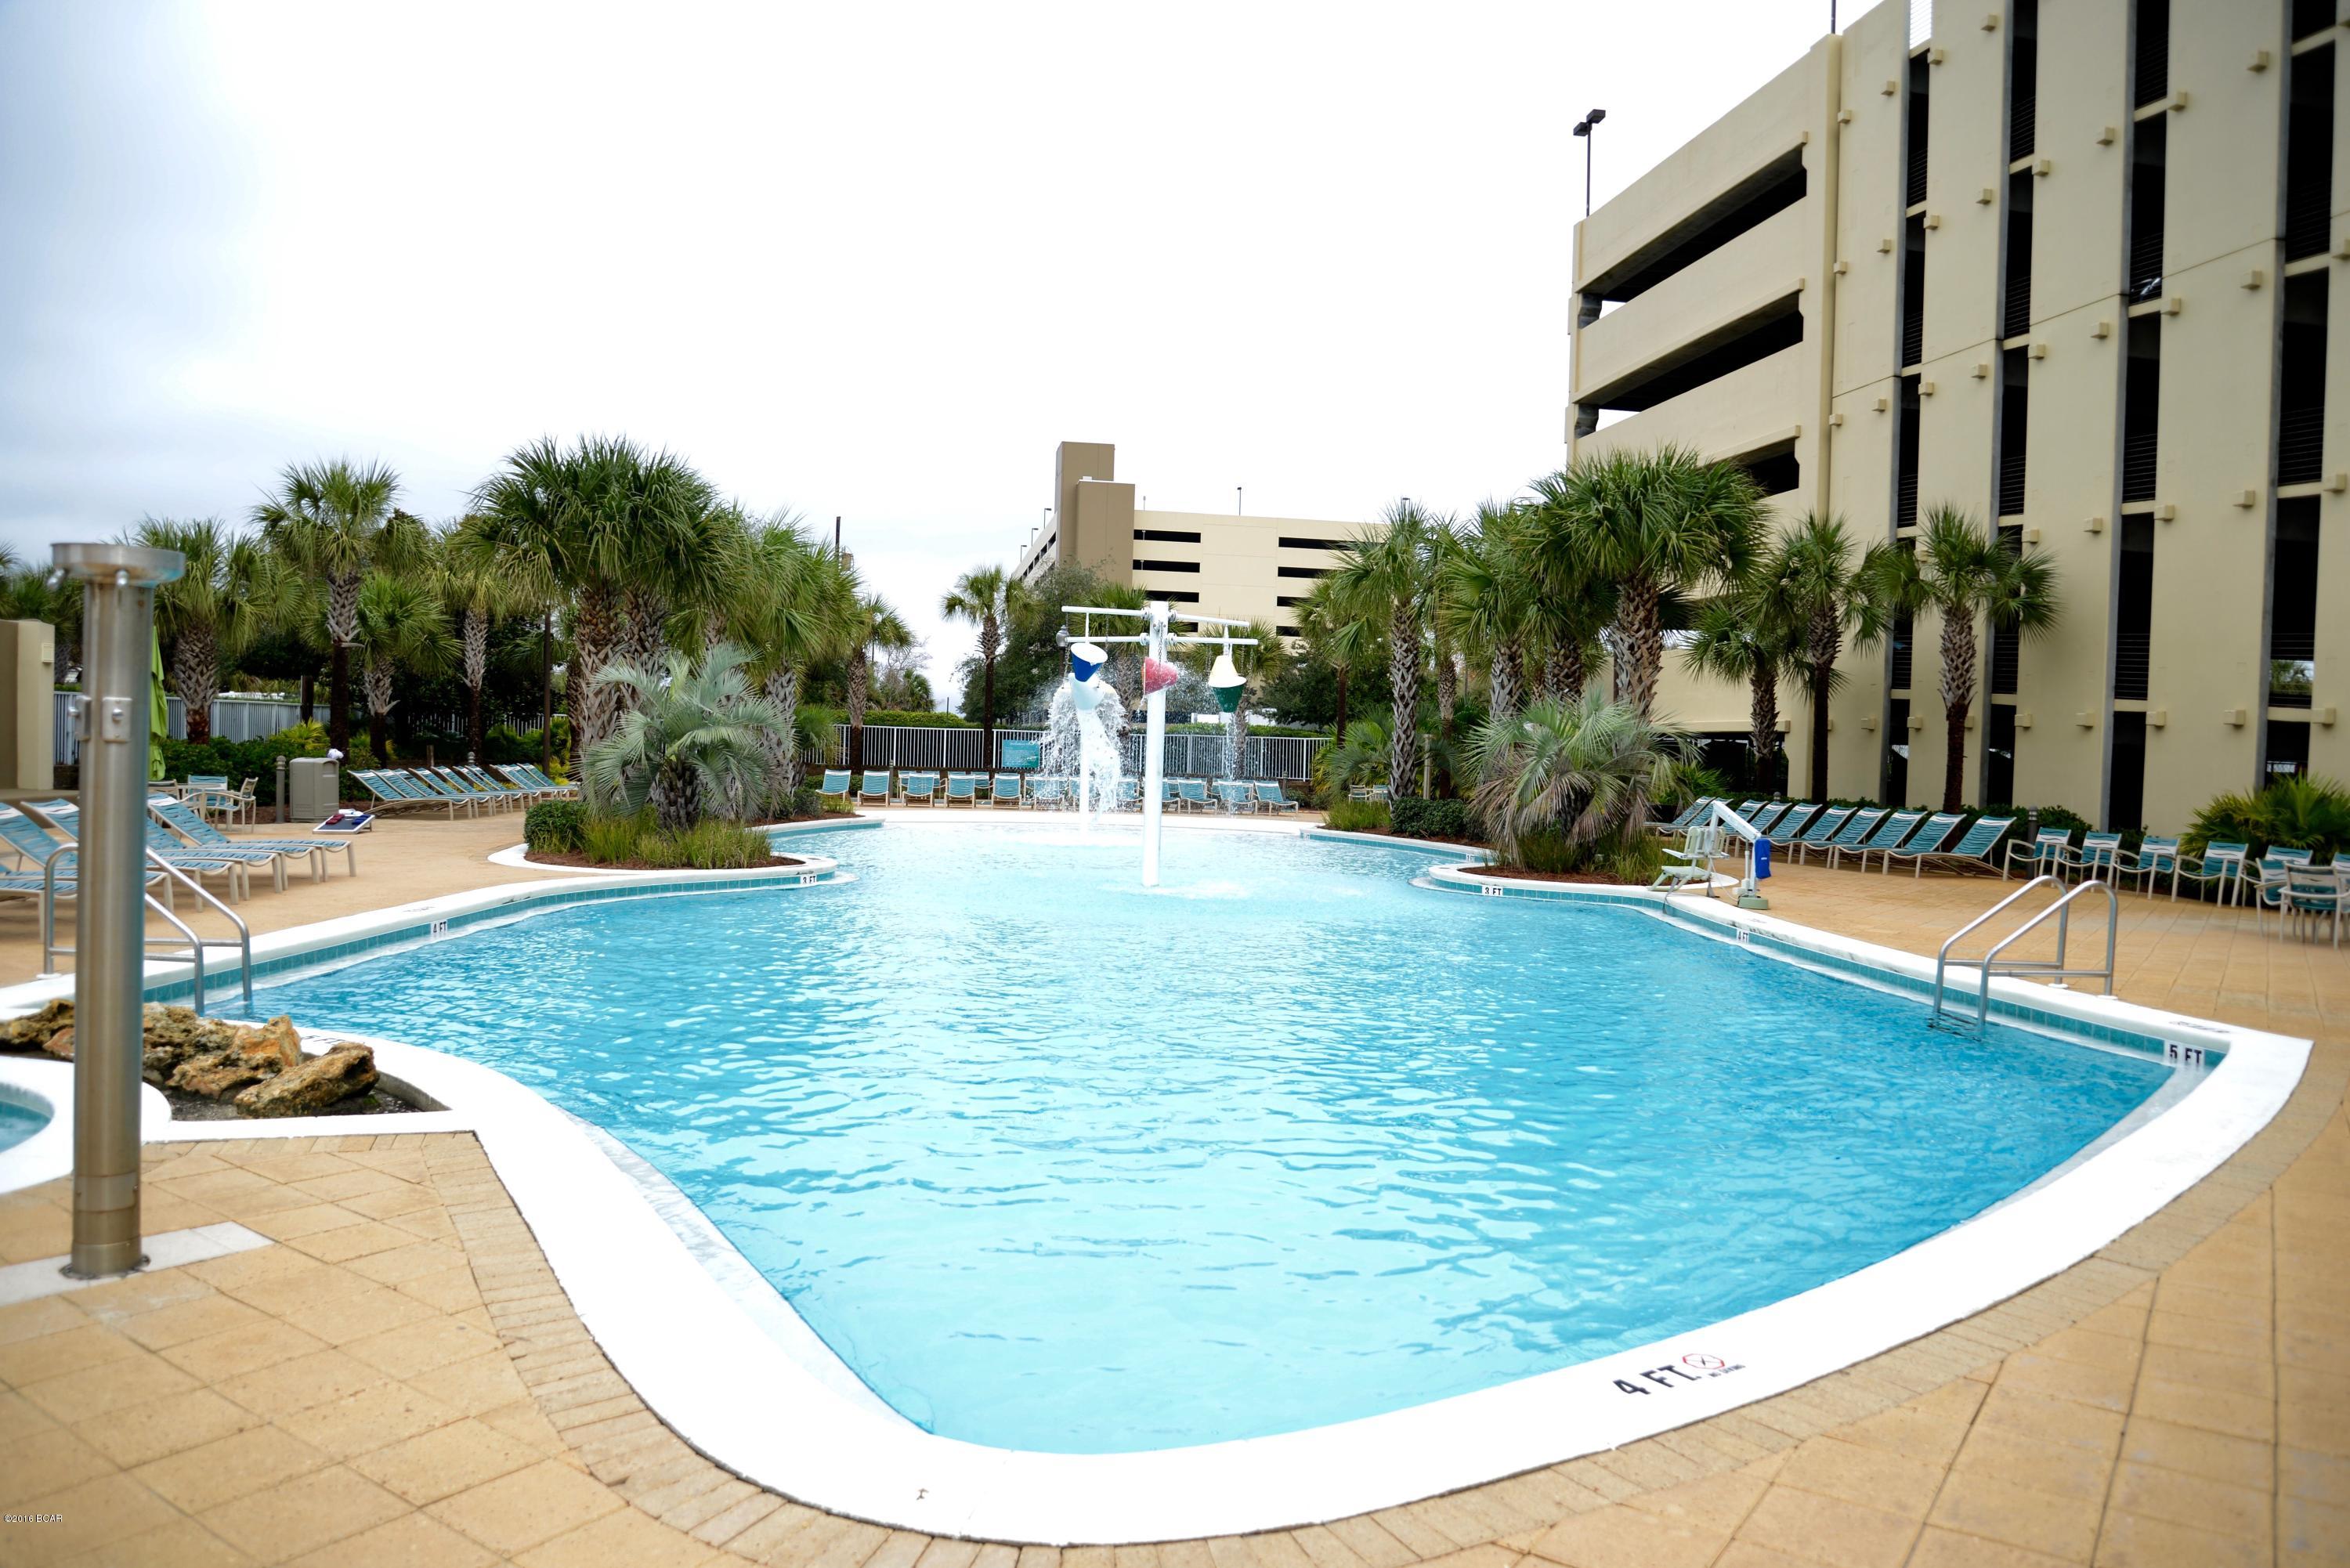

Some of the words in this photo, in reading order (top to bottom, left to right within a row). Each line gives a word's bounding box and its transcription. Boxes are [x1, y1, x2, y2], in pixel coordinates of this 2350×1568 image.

[809, 875, 816, 883] FT
[433, 923, 437, 933] 4
[439, 921, 447, 932] FT
[2169, 1043, 2178, 1060] 5
[2185, 1046, 2202, 1064] FT
[1612, 1378, 1651, 1395] 4
